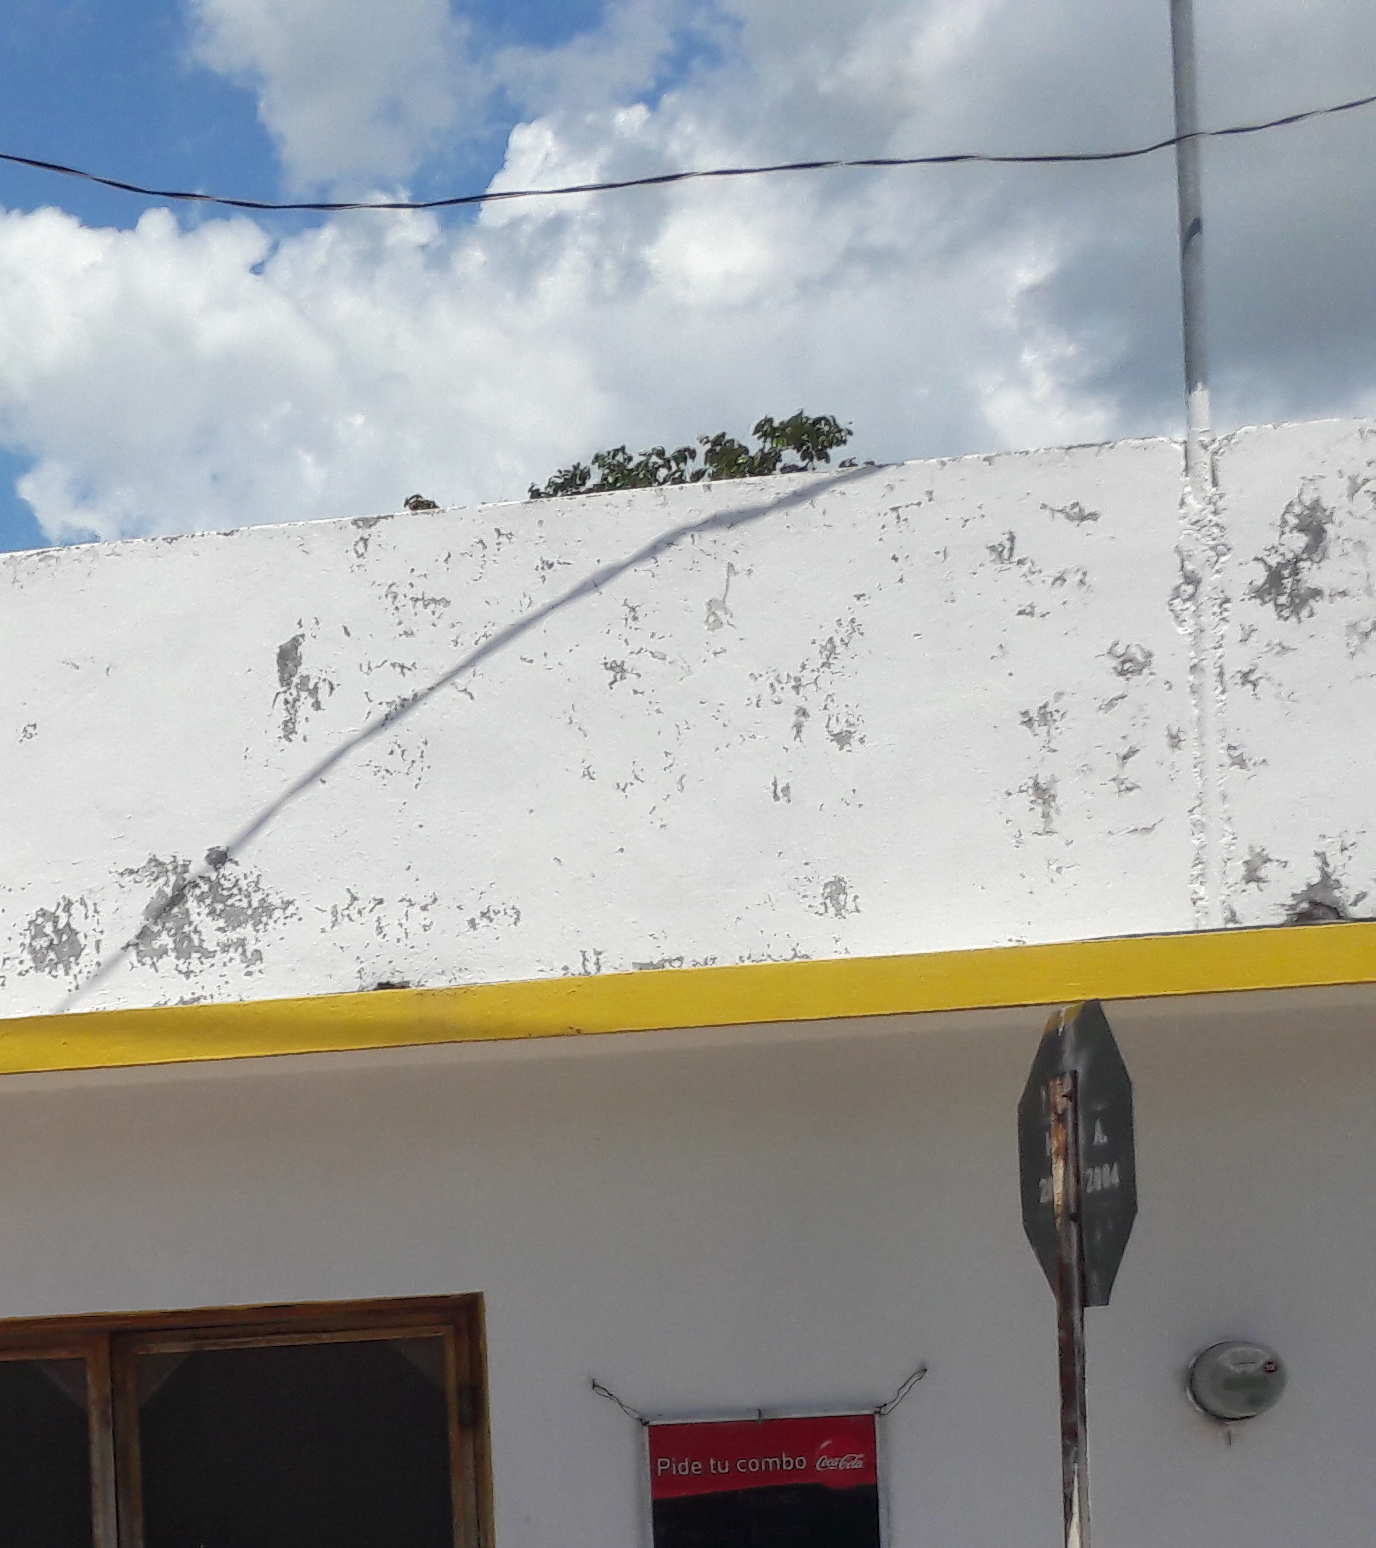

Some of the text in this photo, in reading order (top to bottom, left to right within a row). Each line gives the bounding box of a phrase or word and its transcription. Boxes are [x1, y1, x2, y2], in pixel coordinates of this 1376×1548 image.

[657, 1457, 702, 1476] Pide
[710, 1457, 729, 1473] tu
[736, 1452, 807, 1472] combo
